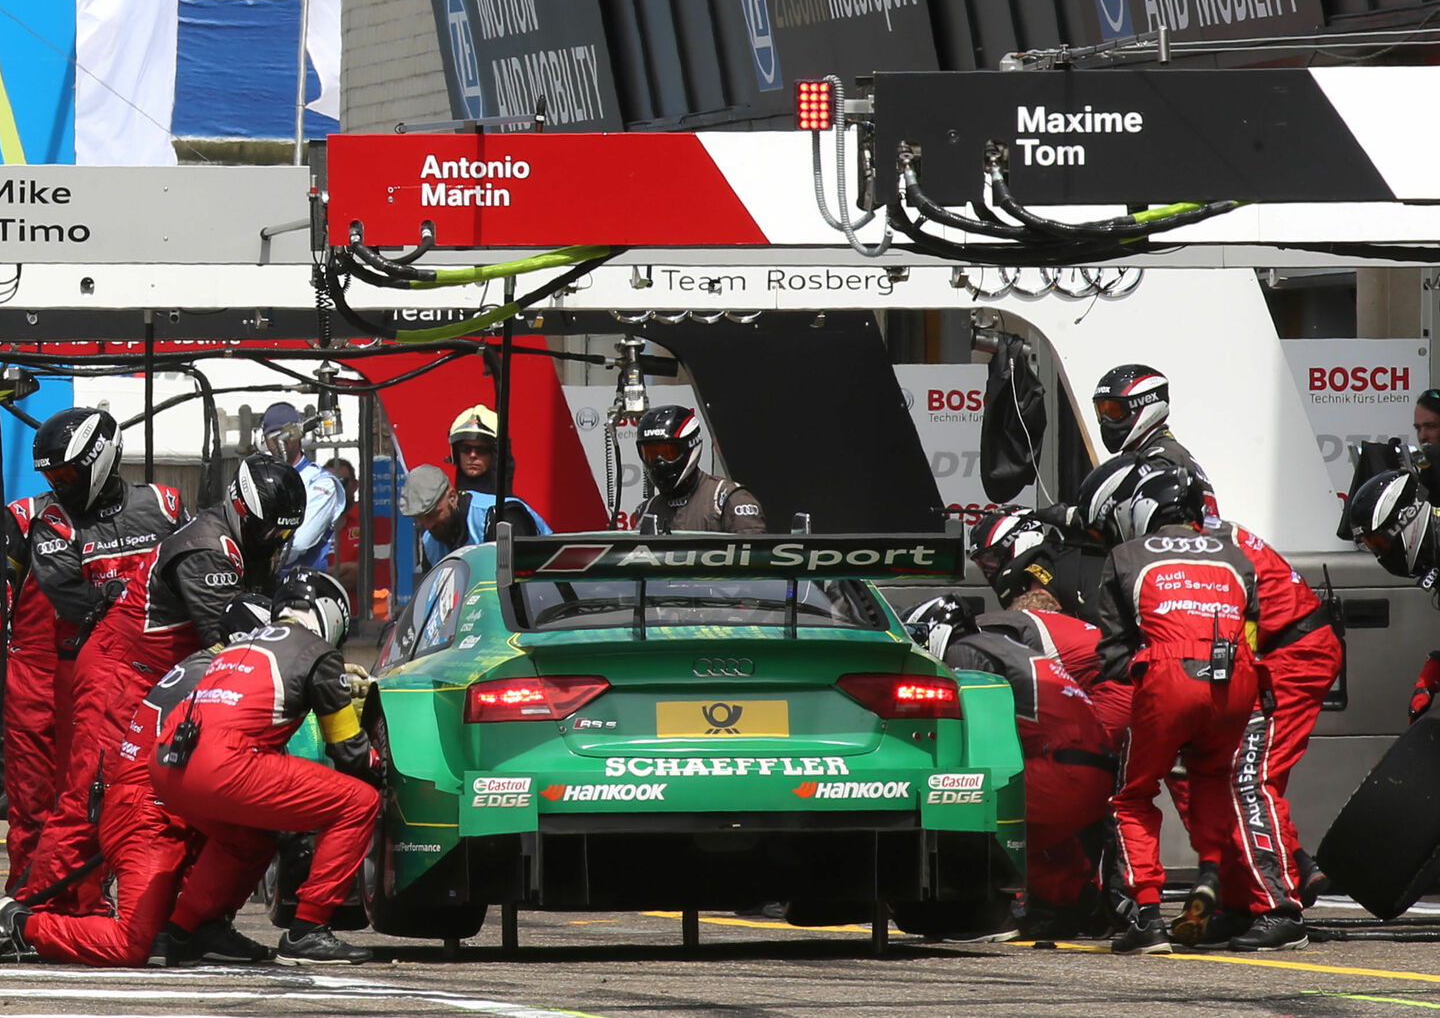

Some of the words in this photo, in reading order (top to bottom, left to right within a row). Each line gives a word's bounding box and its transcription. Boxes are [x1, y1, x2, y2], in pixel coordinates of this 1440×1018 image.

[525, 44, 604, 128] MOBILITY
[1017, 106, 1142, 133] Maxime
[1016, 138, 1085, 165] Tom
[421, 155, 529, 179] Antonio
[421, 182, 510, 206] Martin
[661, 270, 746, 291] Team
[767, 269, 895, 295] Rosberg
[1309, 366, 1410, 392] BOSCH
[928, 389, 988, 412] BOS
[1128, 392, 1159, 409] uvex
[1310, 393, 1351, 404] Technik
[1353, 392, 1375, 404] fürs
[1377, 392, 1410, 403] Leben
[929, 412, 967, 423] Technik
[969, 411, 984, 423] für
[643, 428, 667, 437] uvex
[81, 433, 107, 466] uvex
[931, 451, 980, 478] DT
[277, 516, 301, 526] uvex
[1387, 497, 1424, 537] uvex
[96, 539, 125, 551] Audi
[126, 533, 157, 547] Sport
[617, 544, 751, 567] Audi
[770, 544, 936, 571] Sport
[1155, 570, 1185, 582] Audi
[1156, 581, 1182, 592] Top
[1185, 579, 1230, 592] Service
[605, 720, 617, 729] 5
[605, 756, 849, 777] SCHAEFFLER
[1239, 733, 1260, 783] Sport
[487, 779, 527, 792] Castrol
[941, 775, 981, 788] Castrol
[472, 793, 532, 808] EDGE
[926, 790, 984, 804] EDGE
[1240, 784, 1264, 828] Audi
